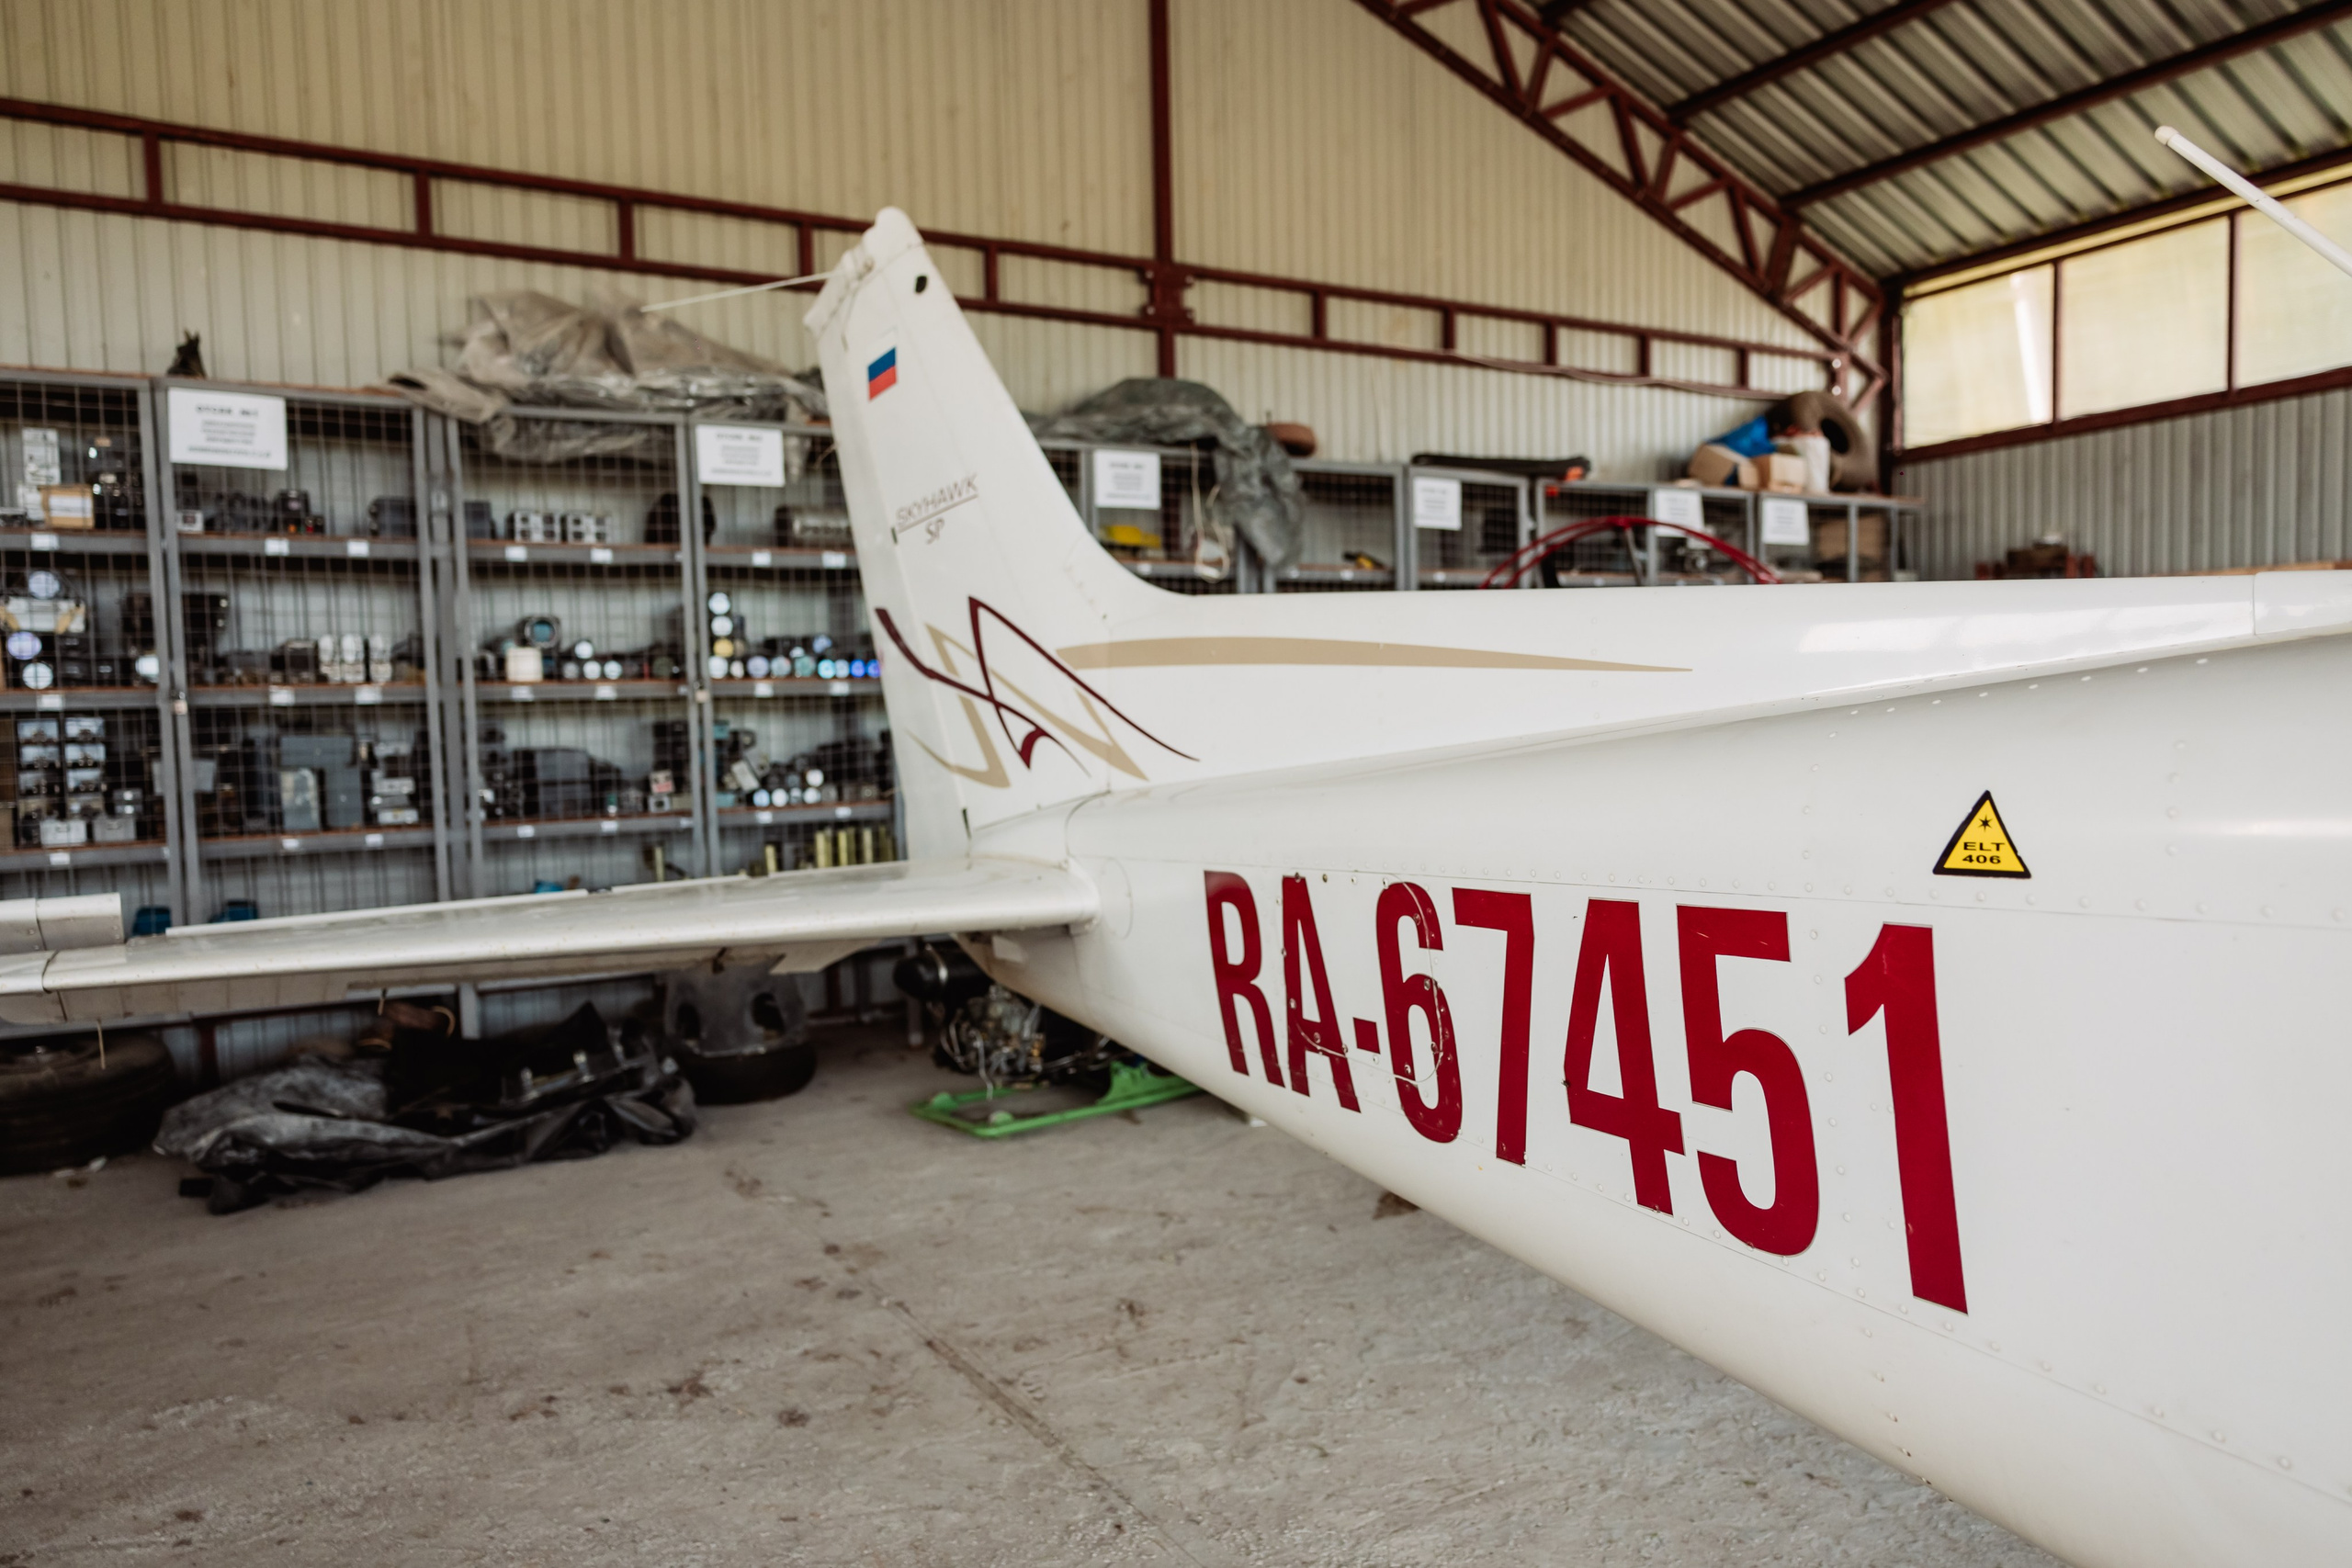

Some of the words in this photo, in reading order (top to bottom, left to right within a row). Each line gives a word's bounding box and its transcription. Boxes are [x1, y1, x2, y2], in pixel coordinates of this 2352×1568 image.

[895, 472, 978, 529] SKYHAWK
[925, 517, 945, 545] SP
[1962, 841, 2005, 852] ELT
[1962, 854, 2001, 864] 406
[1204, 871, 1968, 1314] RA-67451
